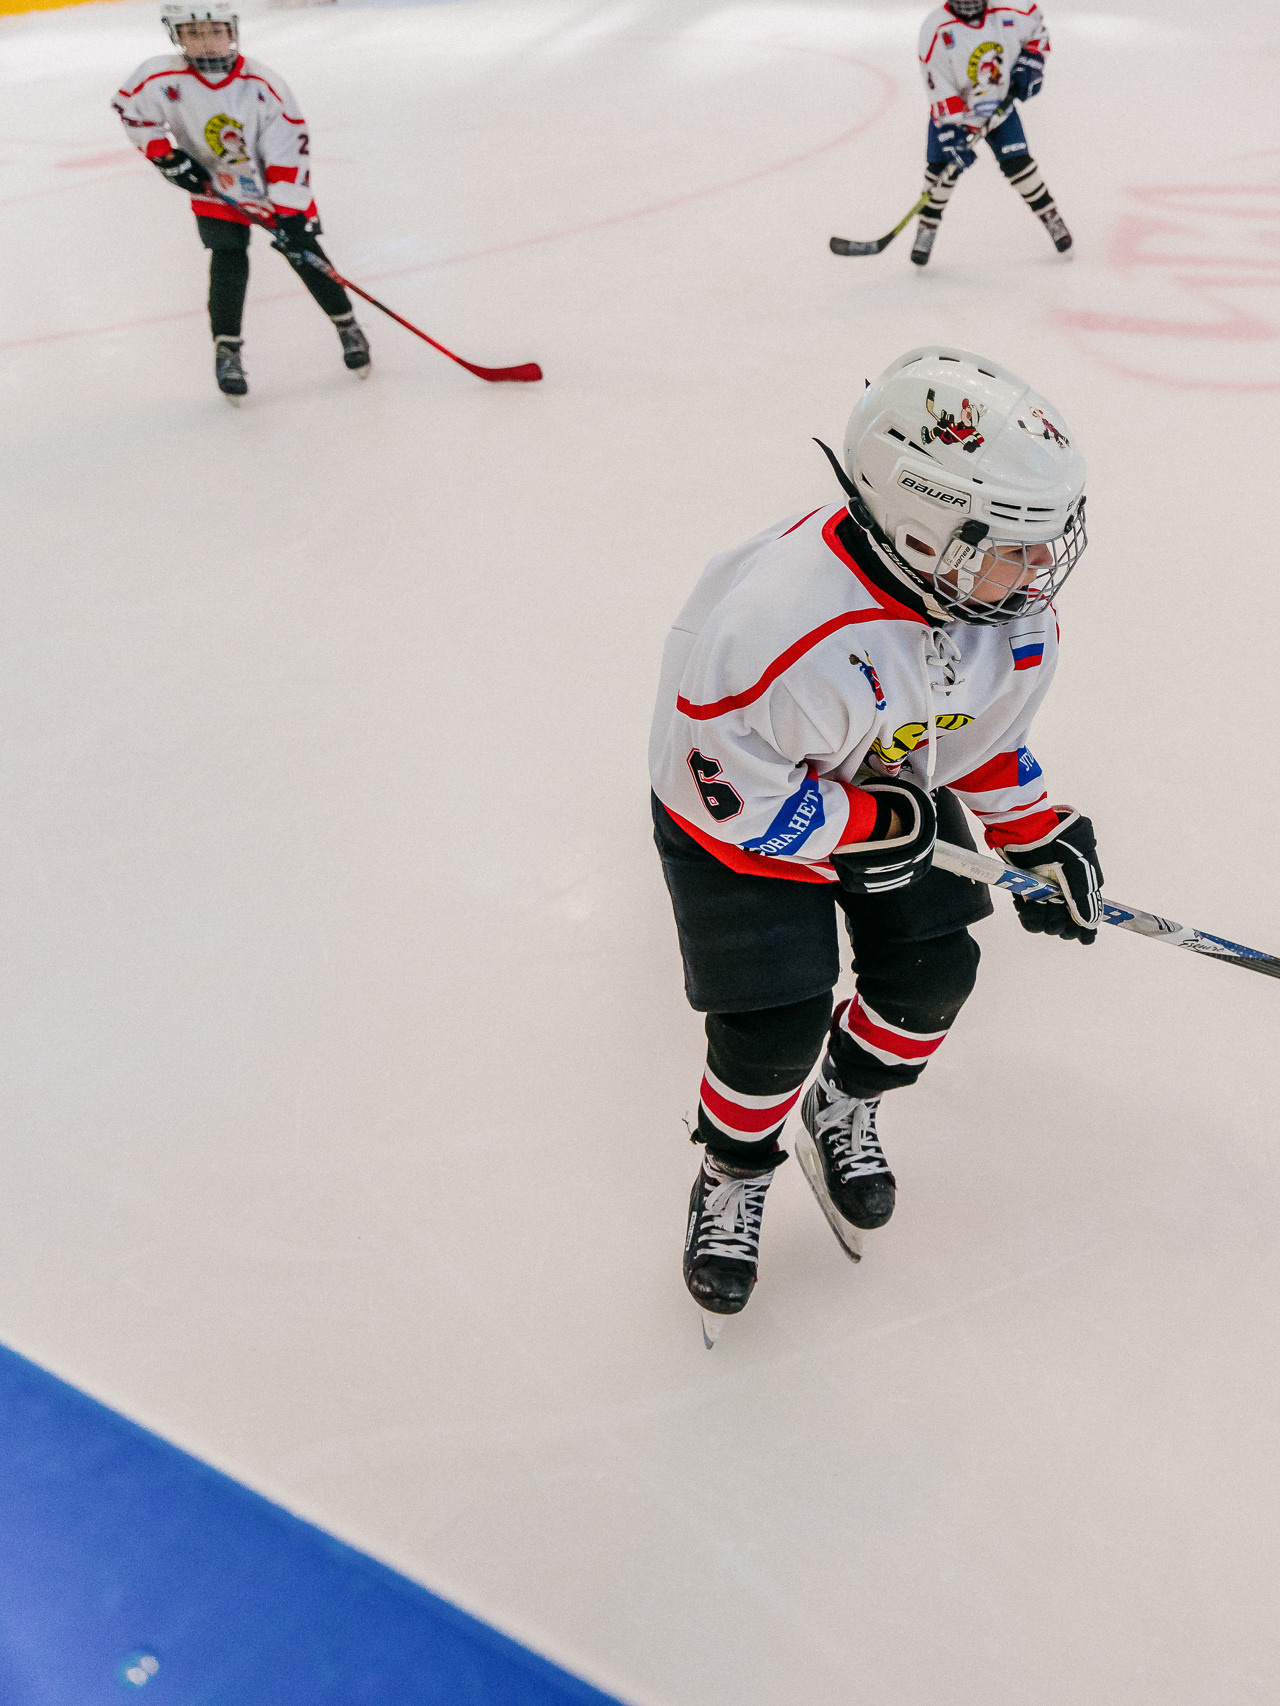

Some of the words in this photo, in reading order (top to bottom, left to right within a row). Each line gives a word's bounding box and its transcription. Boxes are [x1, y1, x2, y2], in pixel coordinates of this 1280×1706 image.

[900, 476, 968, 508] BAUER
[687, 748, 744, 823] 6
[755, 789, 819, 855] ОНА.НЕТ
